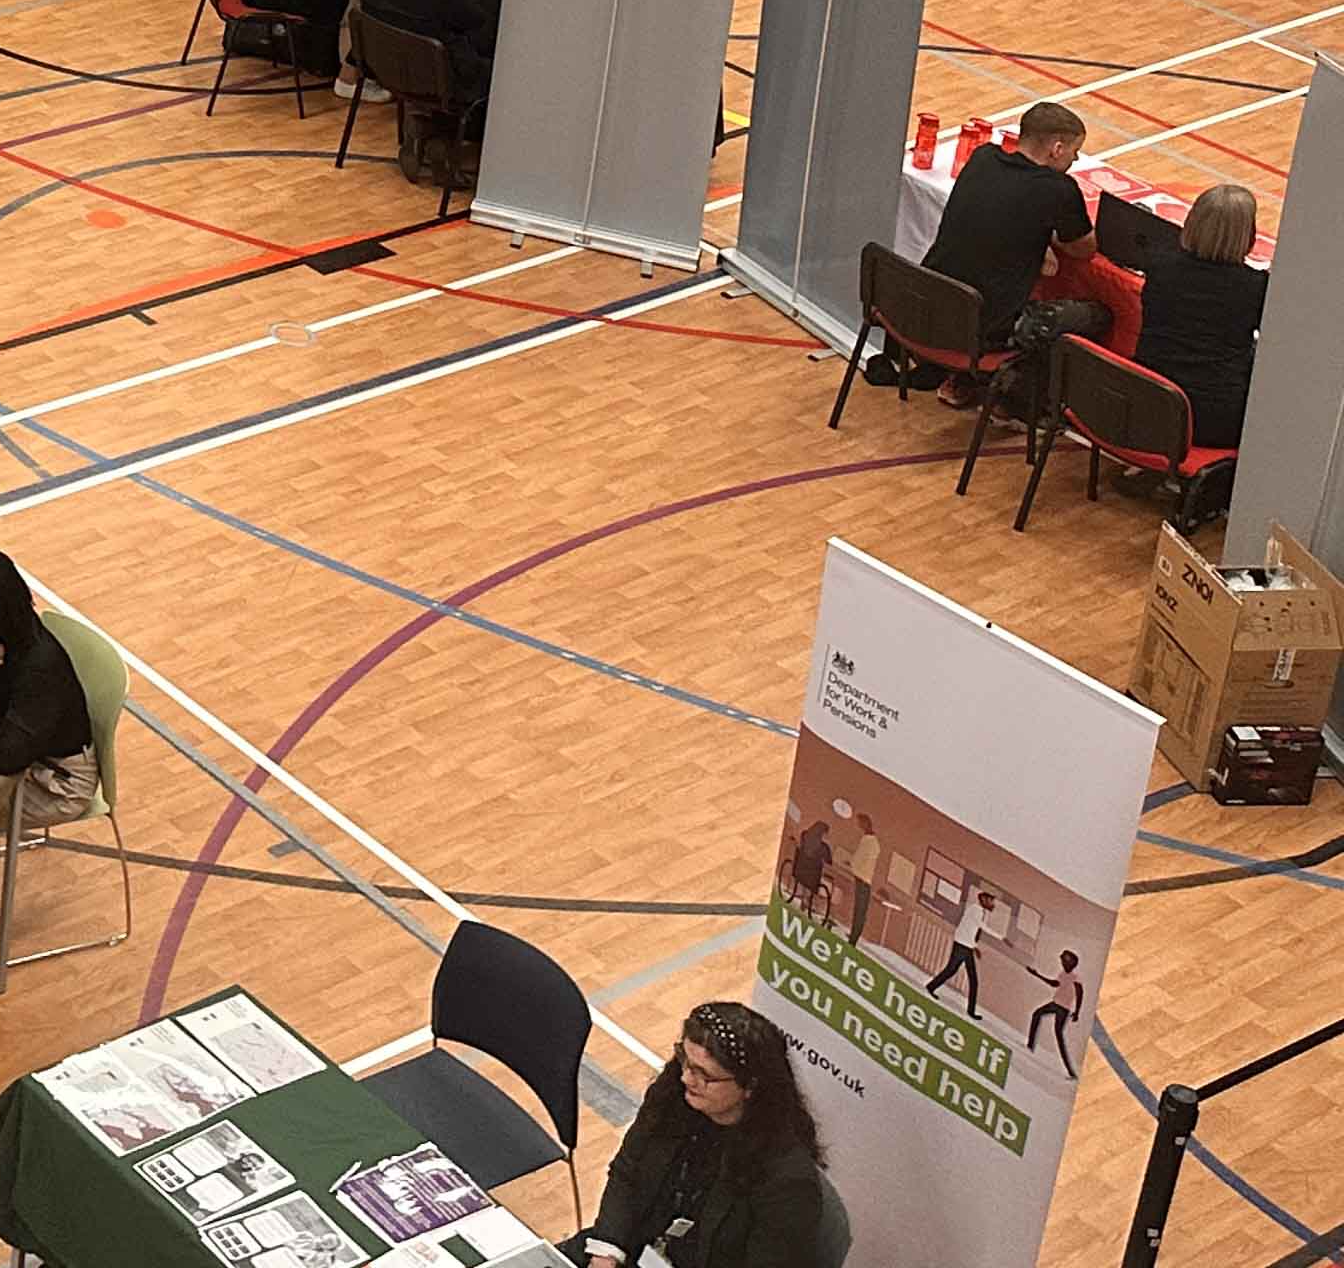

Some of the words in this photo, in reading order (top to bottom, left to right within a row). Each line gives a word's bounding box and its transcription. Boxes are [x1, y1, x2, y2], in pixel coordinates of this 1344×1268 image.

[823, 698, 876, 739] Pensions
[825, 684, 841, 700] for
[844, 696, 876, 723] Work
[878, 716, 888, 729] &
[828, 671, 899, 722] Department
[780, 908, 875, 992] We're
[884, 982, 966, 1052] here
[976, 1040, 1006, 1075] if
[769, 961, 832, 1018] you
[843, 1010, 928, 1085] need
[937, 1071, 1019, 1142] help
[782, 1031, 865, 1099] w.gov.uk
